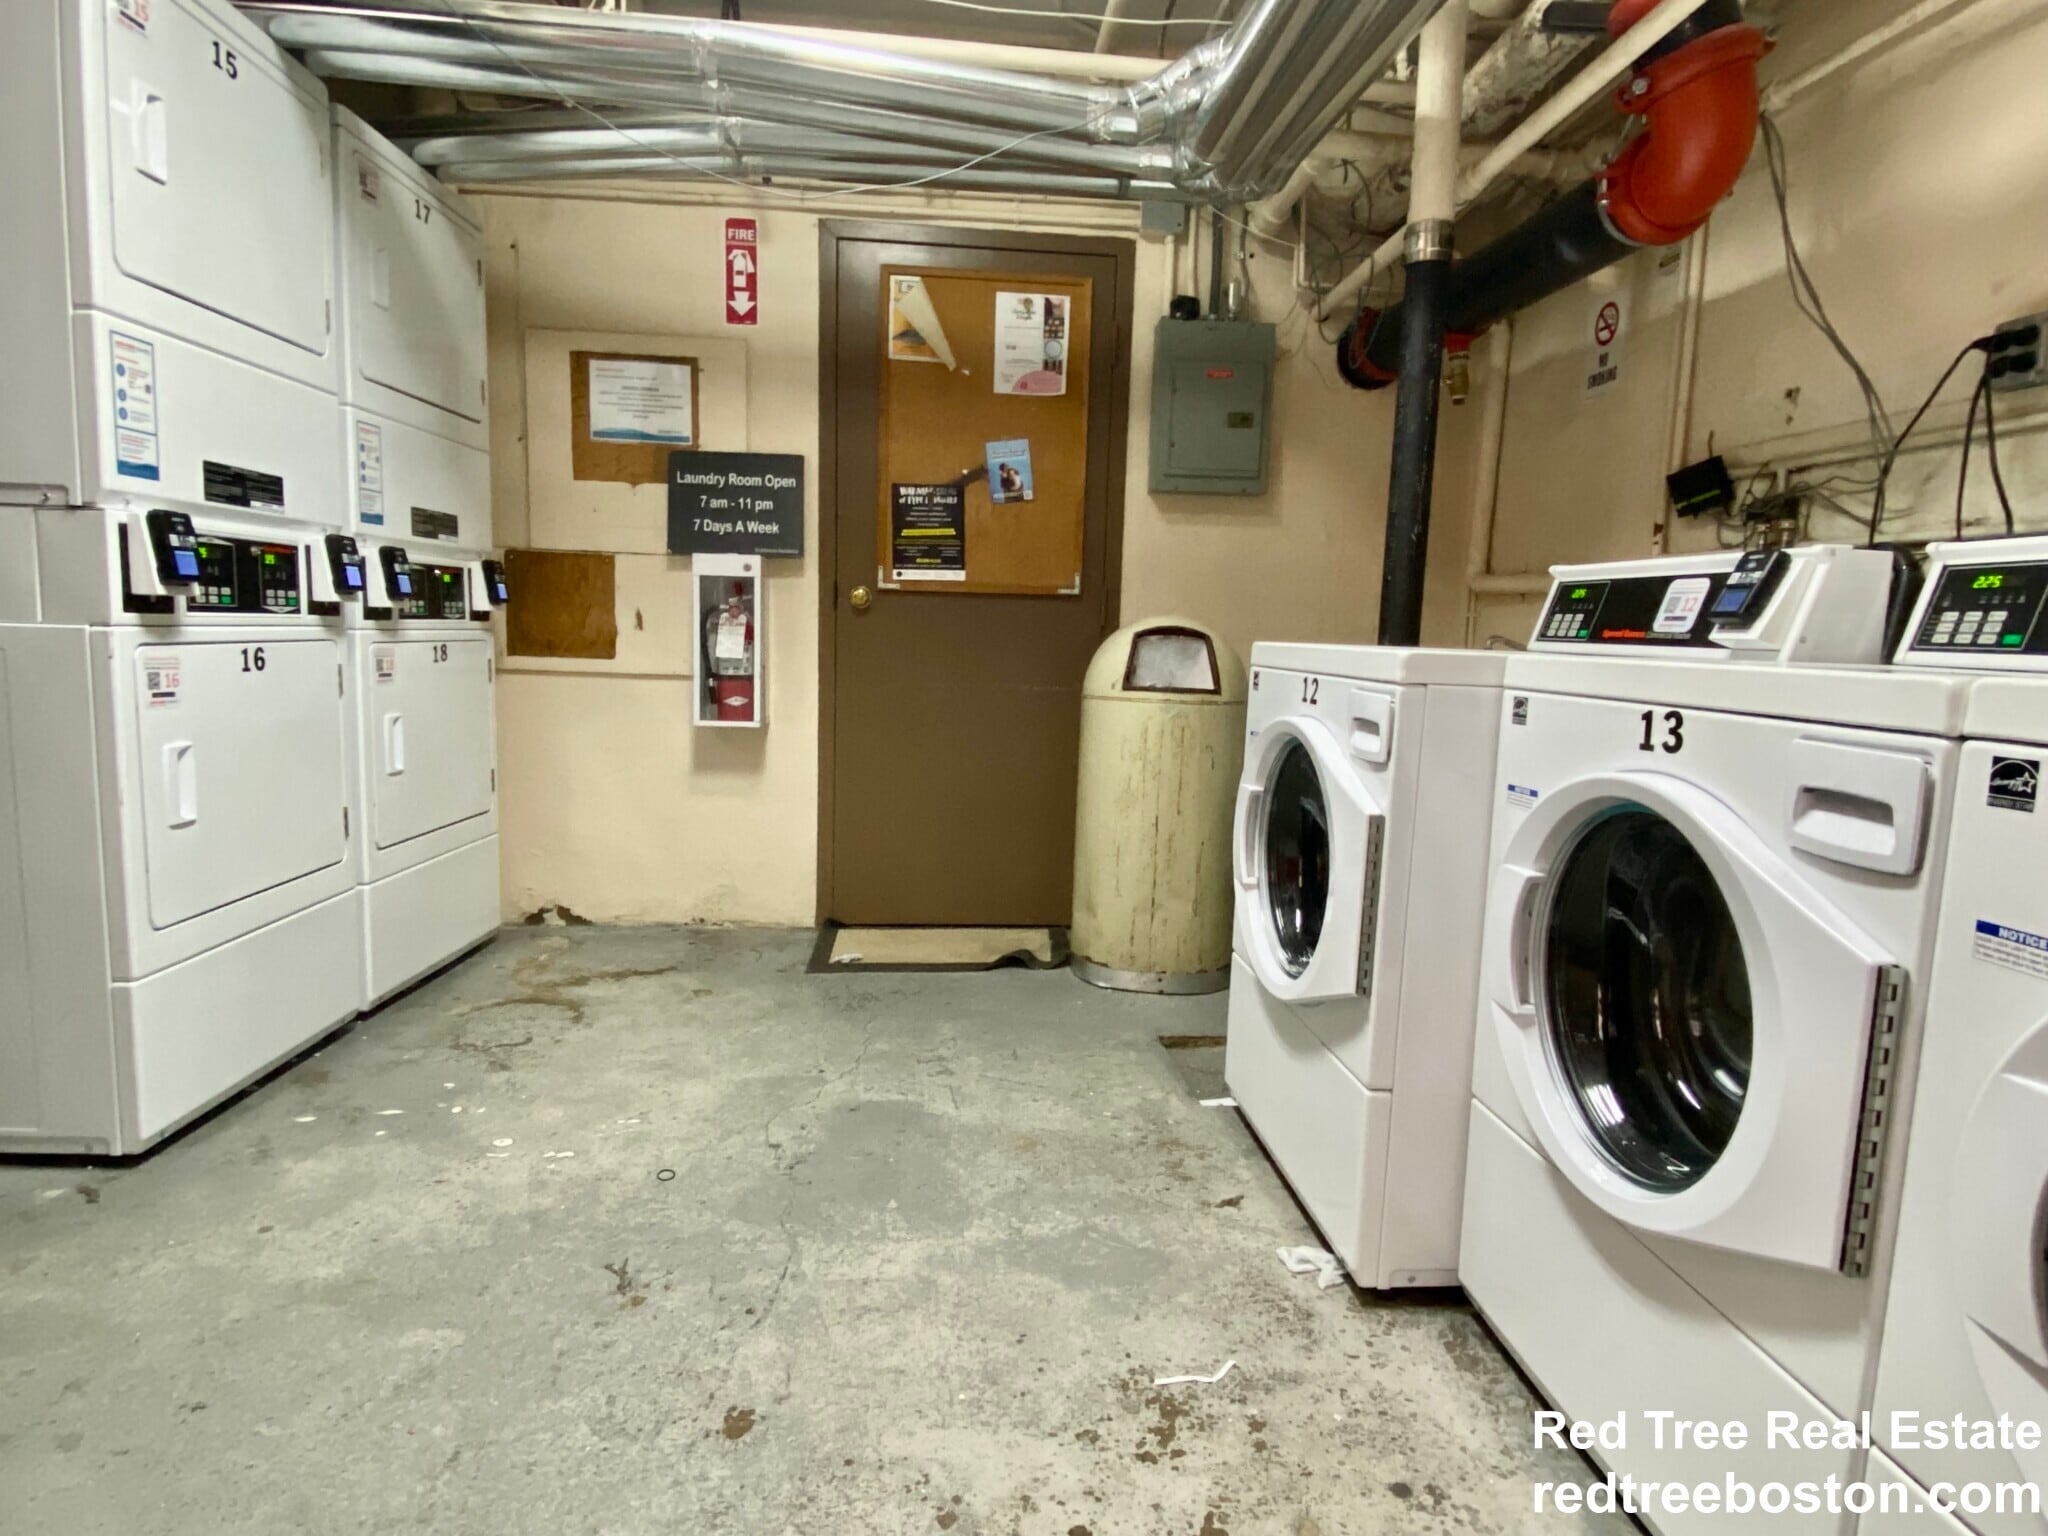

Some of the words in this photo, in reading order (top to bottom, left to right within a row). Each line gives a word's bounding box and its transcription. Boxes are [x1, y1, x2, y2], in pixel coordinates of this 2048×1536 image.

[212, 41, 237, 80] 15
[415, 199, 430, 224] 17
[727, 228, 755, 241] FIRE
[676, 470, 725, 488] Laundry
[728, 472, 762, 486] Room
[764, 474, 797, 490] Open
[700, 495, 707, 508] 7
[709, 498, 728, 509] am
[738, 497, 751, 510] 11
[755, 500, 773, 513] pm
[693, 519, 701, 532] 7
[703, 519, 732, 535] Days
[735, 520, 744, 533] A
[746, 521, 779, 534] Week
[1972, 575, 2003, 589] 225
[241, 646, 265, 672] 16
[433, 644, 447, 663] 18
[1302, 677, 1319, 705] 12
[1639, 710, 1683, 754] 13
[1998, 927, 2047, 950] NOTICE
